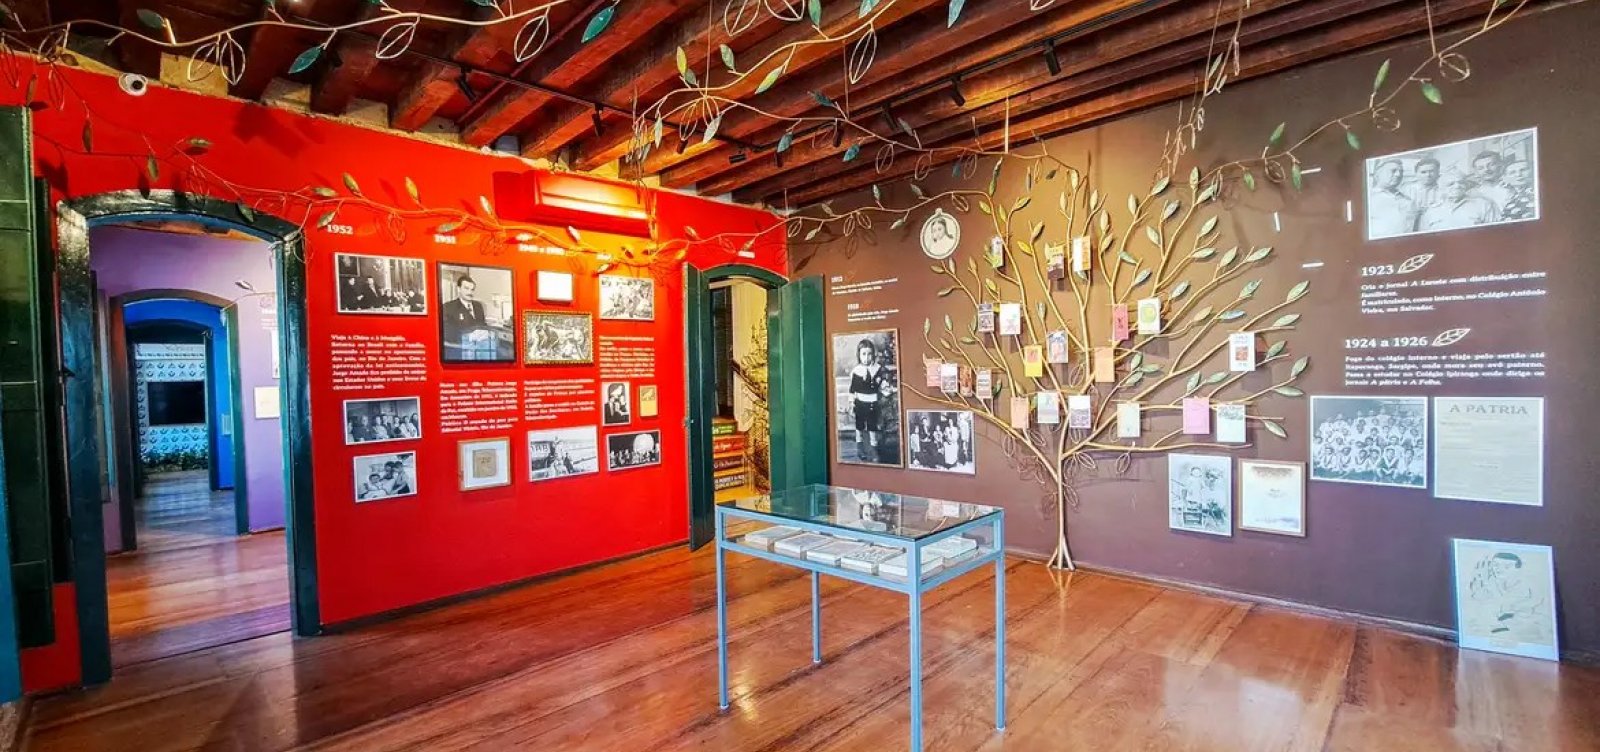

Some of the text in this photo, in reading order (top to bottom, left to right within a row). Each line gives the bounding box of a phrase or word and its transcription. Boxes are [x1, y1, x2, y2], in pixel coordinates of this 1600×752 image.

[327, 224, 353, 234] 1952
[1361, 265, 1394, 276] 1923
[1385, 281, 1407, 290] jornal
[1470, 273, 1518, 283] distribuição
[1522, 271, 1546, 279] entre
[1478, 291, 1508, 300] Colégio
[1345, 336, 1428, 348] 1924 a 1926
[1378, 354, 1405, 362] colégio
[1450, 353, 1470, 361] viaja
[1449, 404, 1528, 414] A PATRIA
